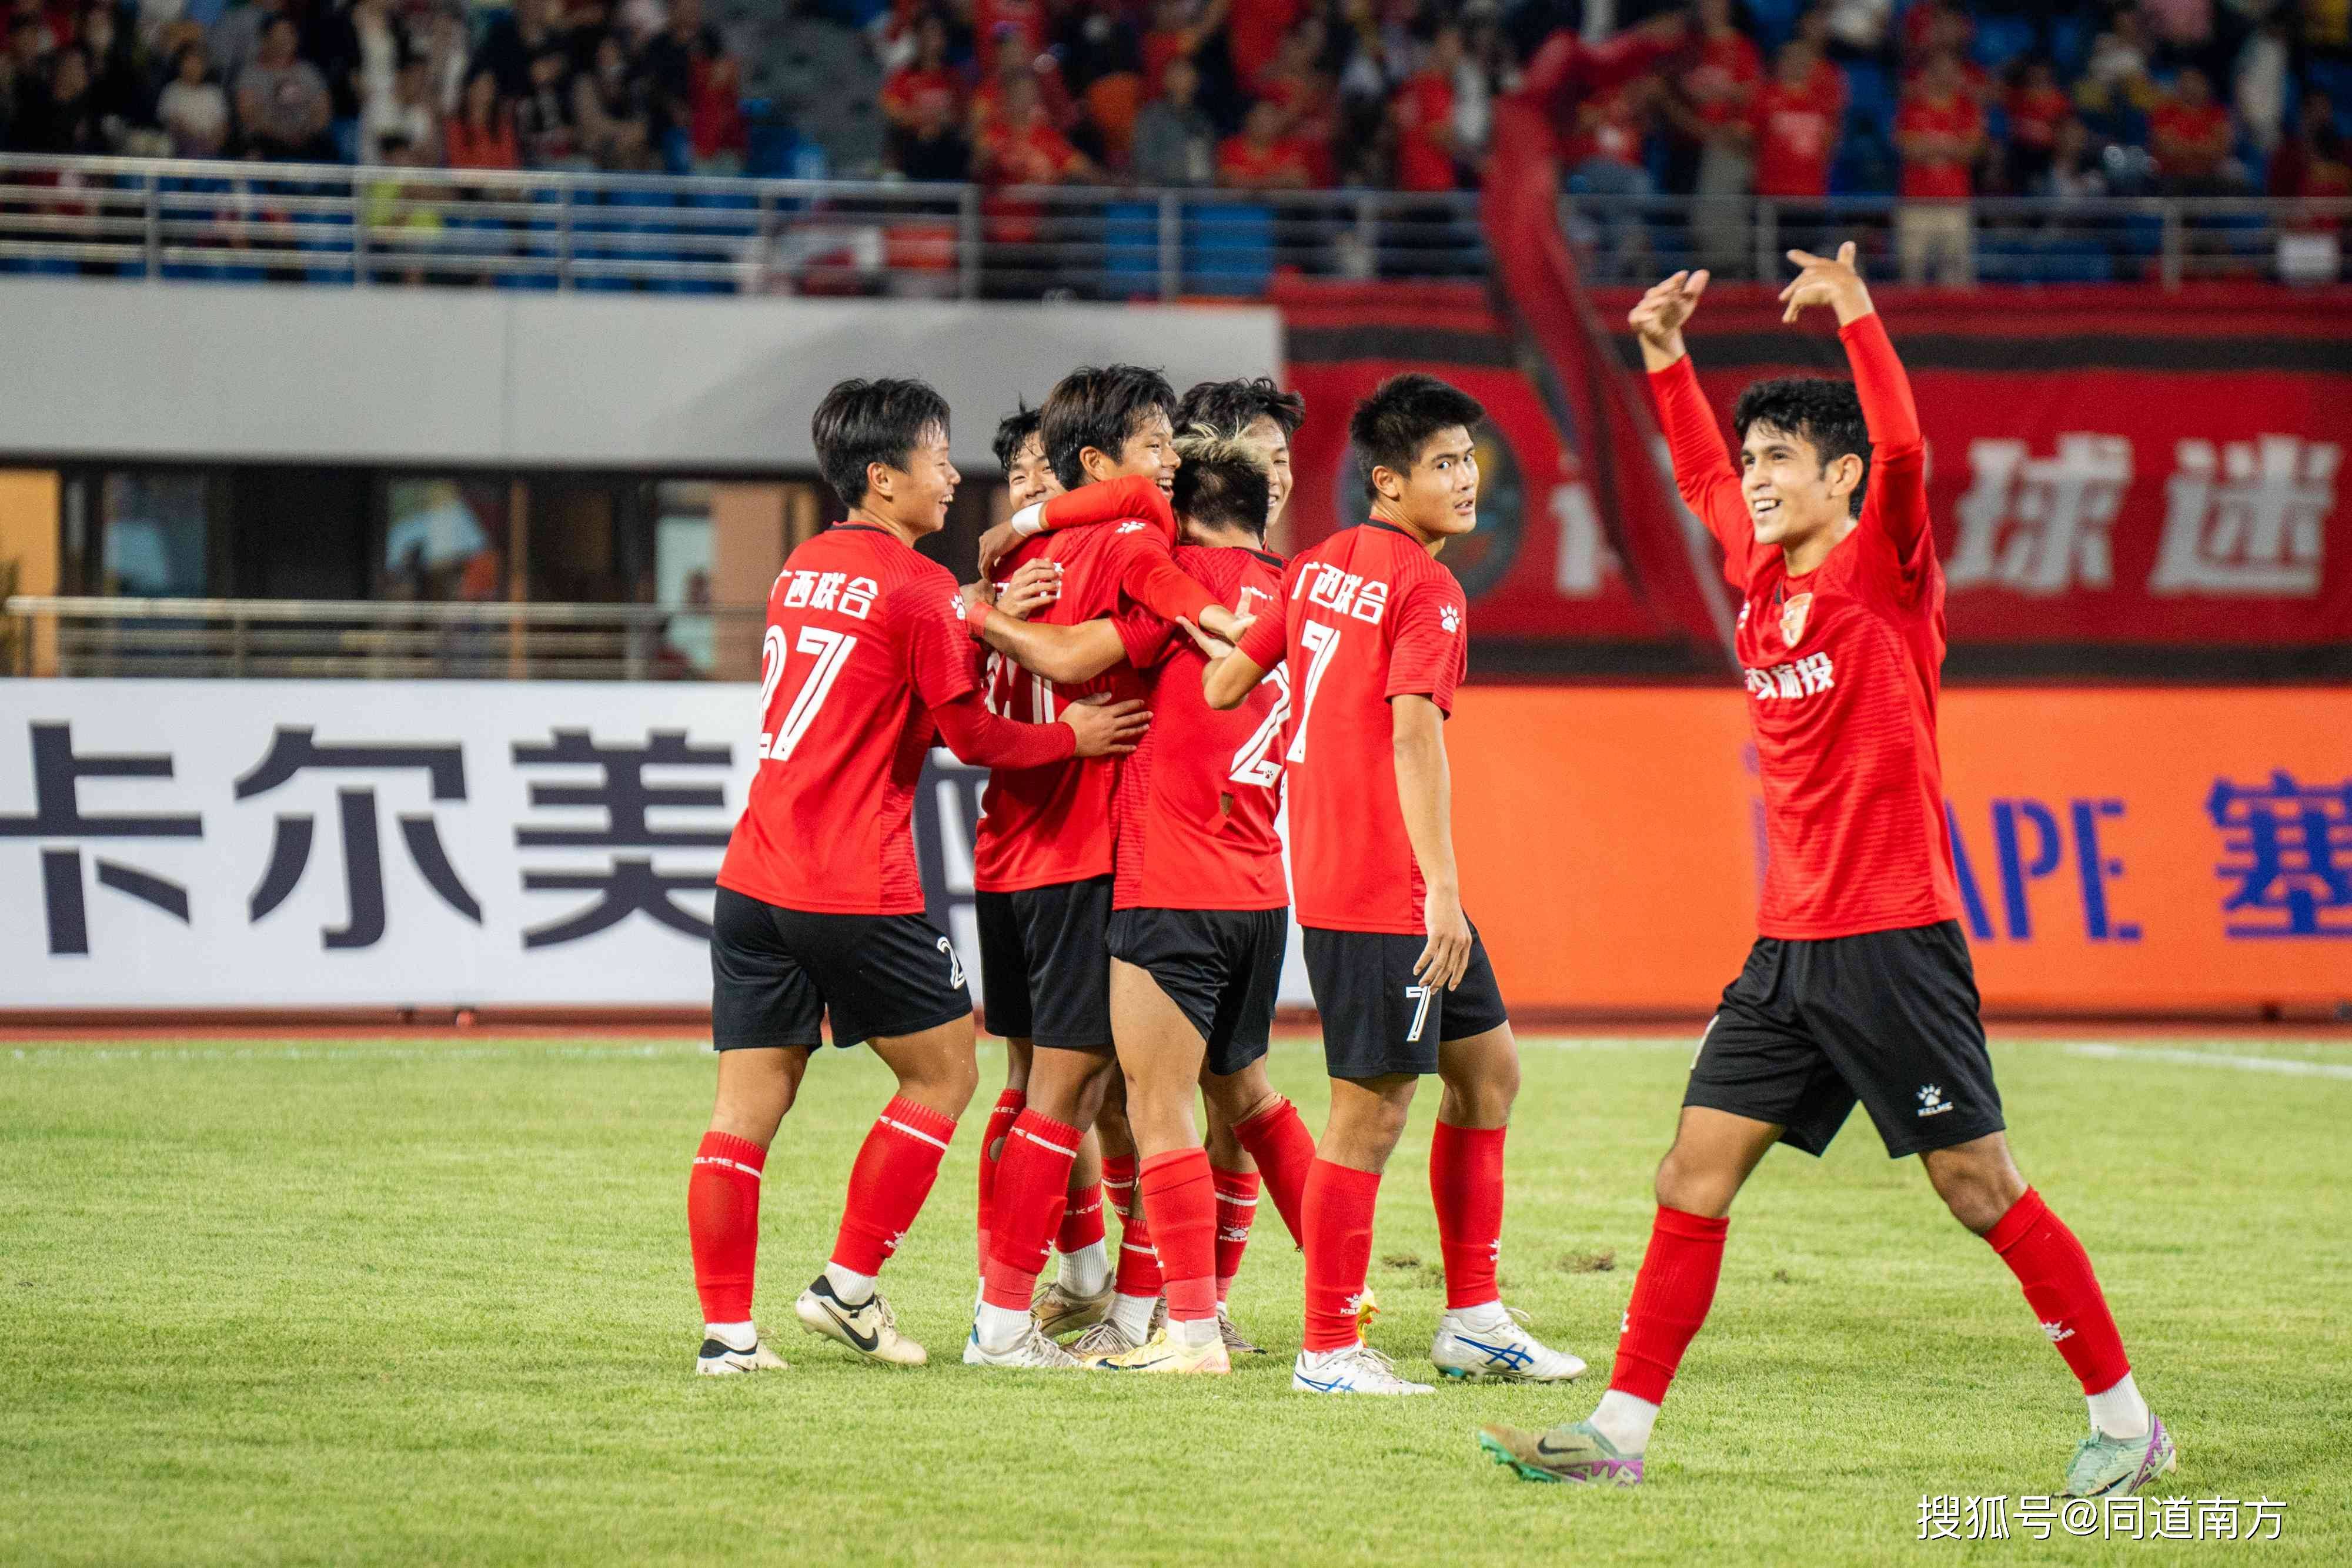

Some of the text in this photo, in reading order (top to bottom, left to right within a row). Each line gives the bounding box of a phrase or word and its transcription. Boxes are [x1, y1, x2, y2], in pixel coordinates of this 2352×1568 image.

[769, 569, 878, 620] 广西联合
[1291, 561, 1388, 625] 广西联合
[759, 624, 858, 761] 27
[1286, 618, 1341, 764] 7
[1405, 984, 1431, 1042] 7
[693, 1156, 733, 1167] ELME
